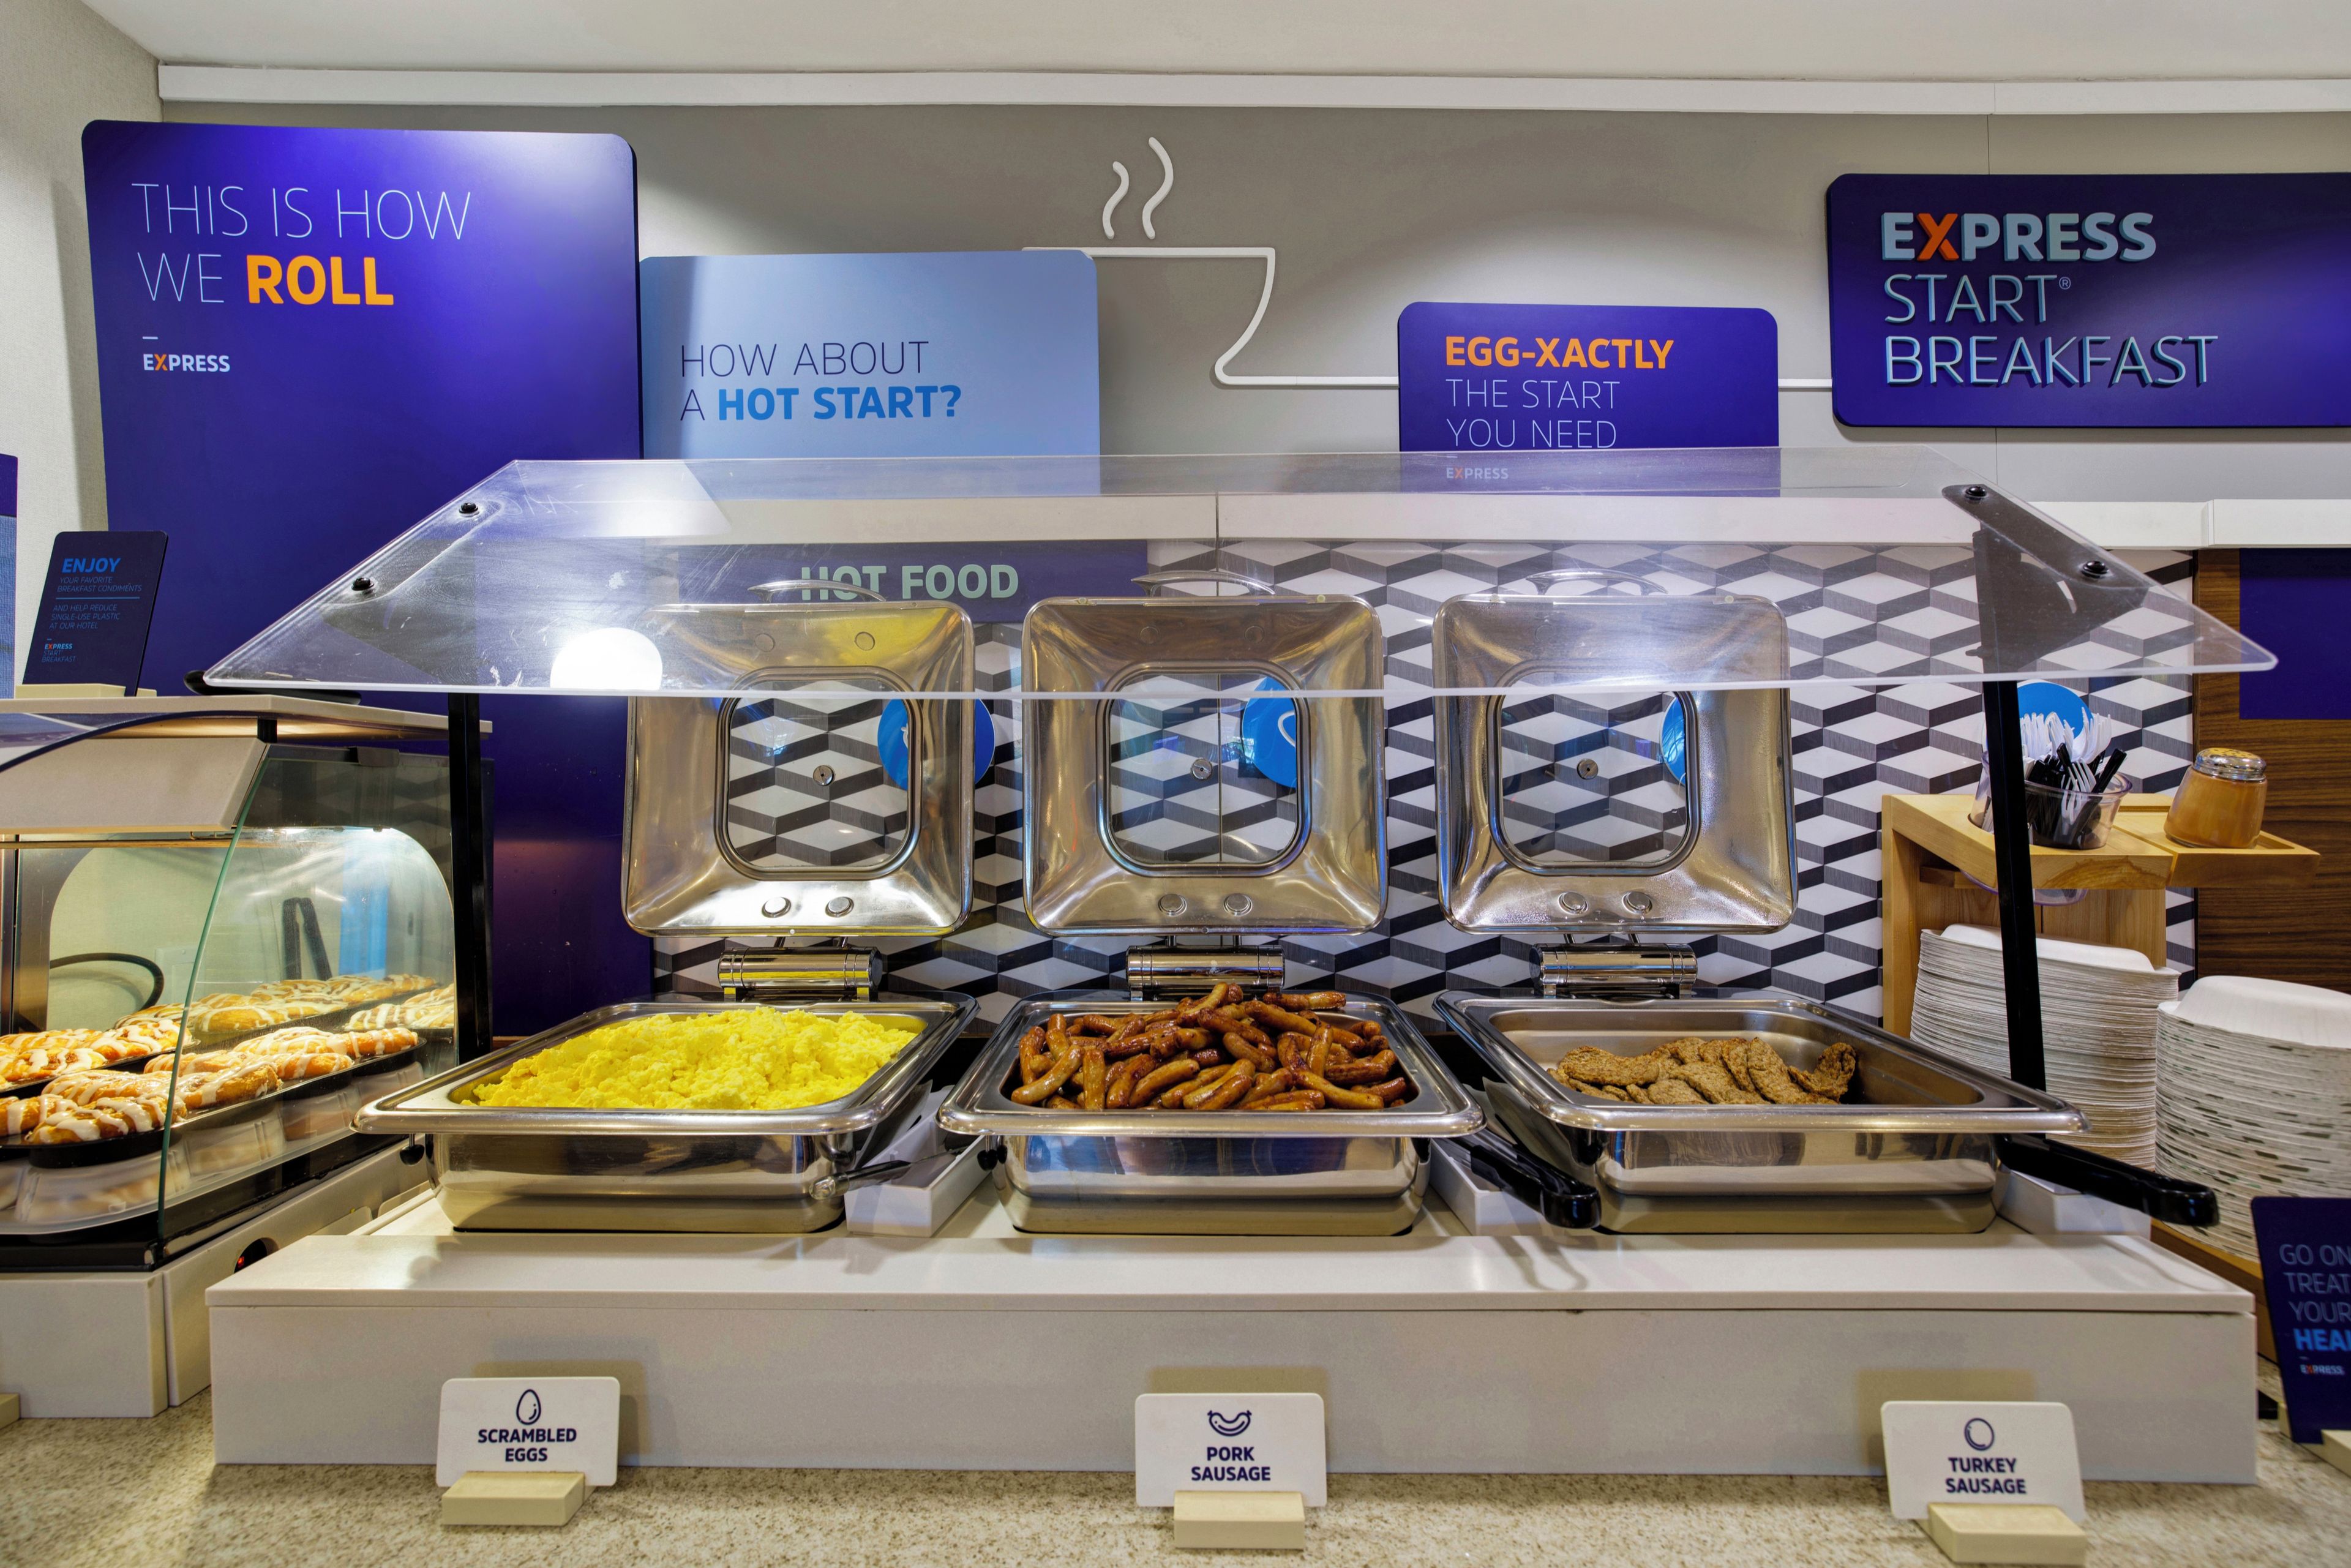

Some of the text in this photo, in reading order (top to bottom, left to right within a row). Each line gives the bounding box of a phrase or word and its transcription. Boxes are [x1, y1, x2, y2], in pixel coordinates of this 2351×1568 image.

[132, 184, 471, 240] THIS IS HOW
[1881, 212, 2156, 262] EXPRESS
[138, 252, 394, 306] WE ROLL
[143, 353, 231, 372] EXPRESS
[681, 341, 929, 377] HOW ABOUT
[1445, 336, 1674, 369] EGG-XACTLY
[1886, 336, 2218, 384] BREAKFAST
[680, 385, 961, 421] A HOT START?
[1445, 378, 1620, 409] THE START
[1446, 418, 1616, 449] YOU NEED
[1446, 467, 1509, 480] EXPRESS
[61, 558, 121, 573] ENJOY
[801, 564, 1019, 601] HOT FOOD
[2279, 1244, 2314, 1266] GO
[2288, 1300, 2351, 1323] YOUR
[2300, 1364, 2345, 1375] EXPRESS
[478, 1428, 577, 1444] SCRAMBLED
[504, 1447, 549, 1462] EGGS
[1206, 1446, 1254, 1461] PORK
[1191, 1466, 1272, 1482] SAUSAGE
[1948, 1457, 2017, 1473] TURKEY
[1945, 1477, 2027, 1494] SAUSAGE
